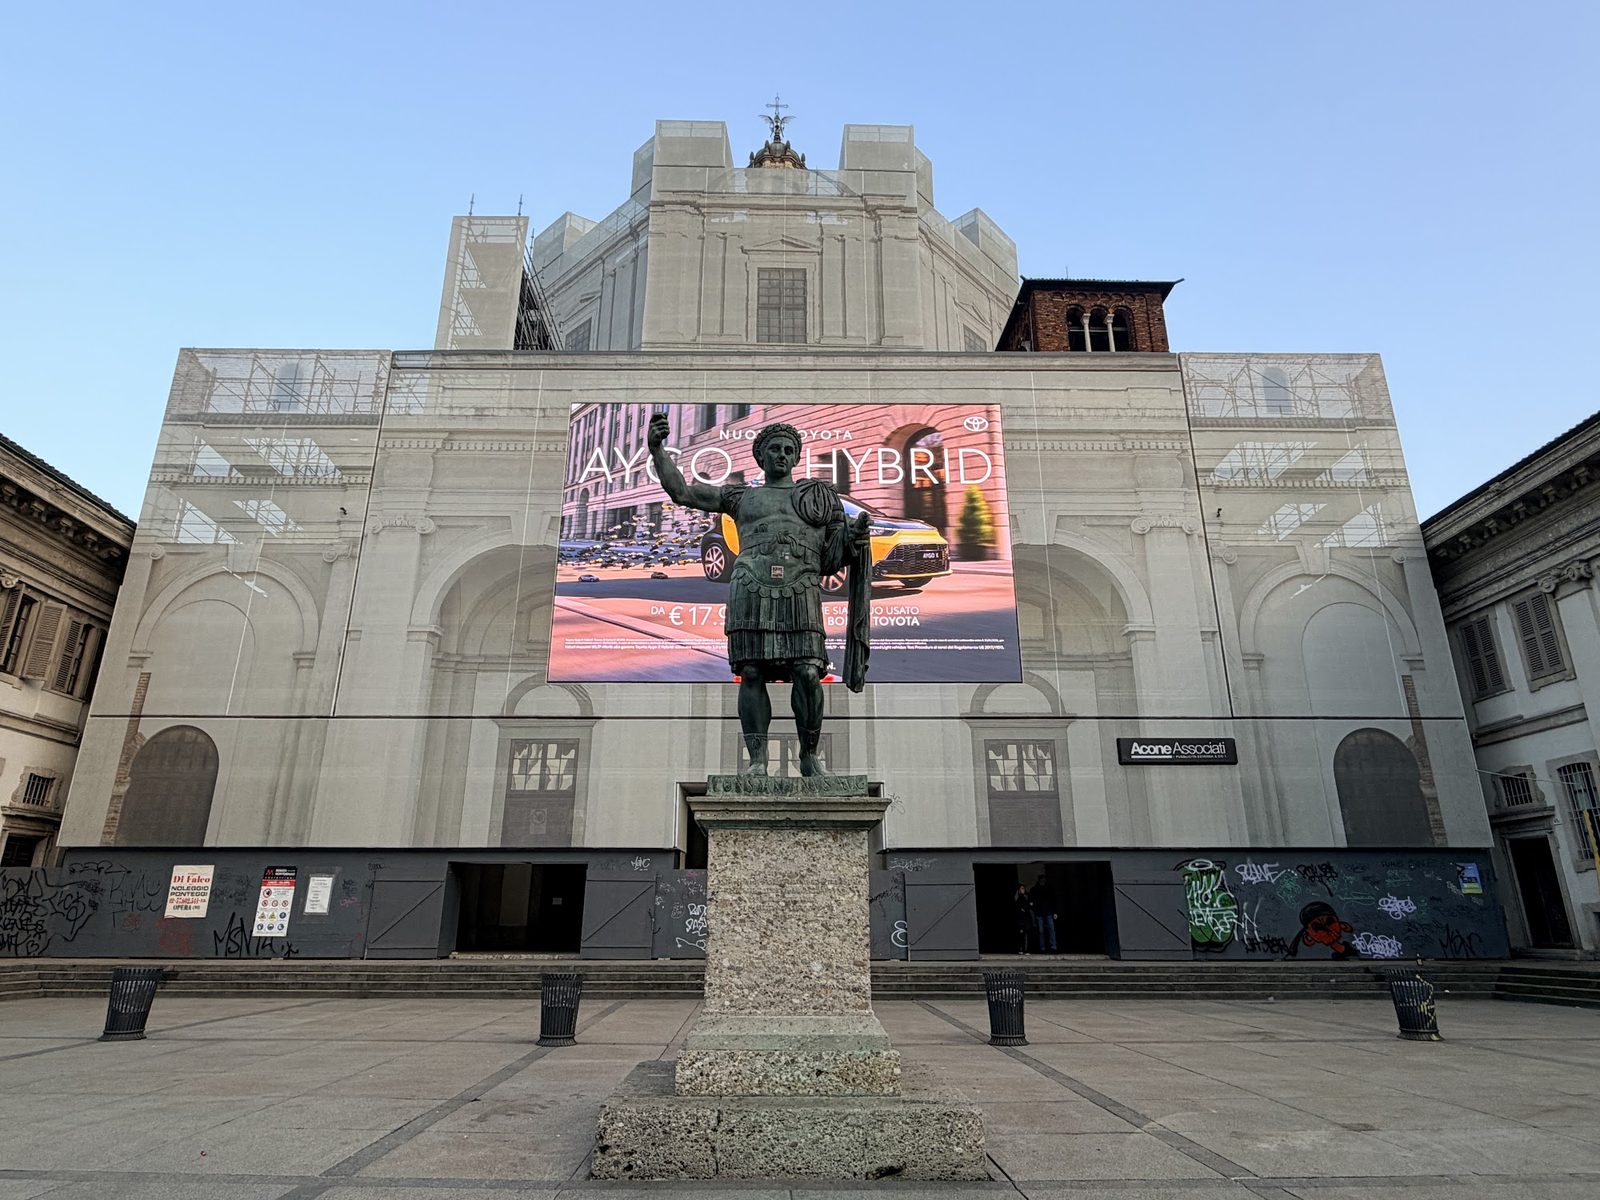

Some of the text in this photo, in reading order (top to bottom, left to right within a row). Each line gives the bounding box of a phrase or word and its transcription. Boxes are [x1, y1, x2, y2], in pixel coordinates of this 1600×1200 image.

[719, 429, 853, 440] NUO OYOTA
[805, 447, 993, 485] HYBRID
[650, 606, 666, 615] DA
[886, 606, 920, 615] USATO
[873, 616, 920, 626] TOYOTA
[1130, 741, 1226, 755] Acone Associati
[173, 875, 210, 883] Di Falco
